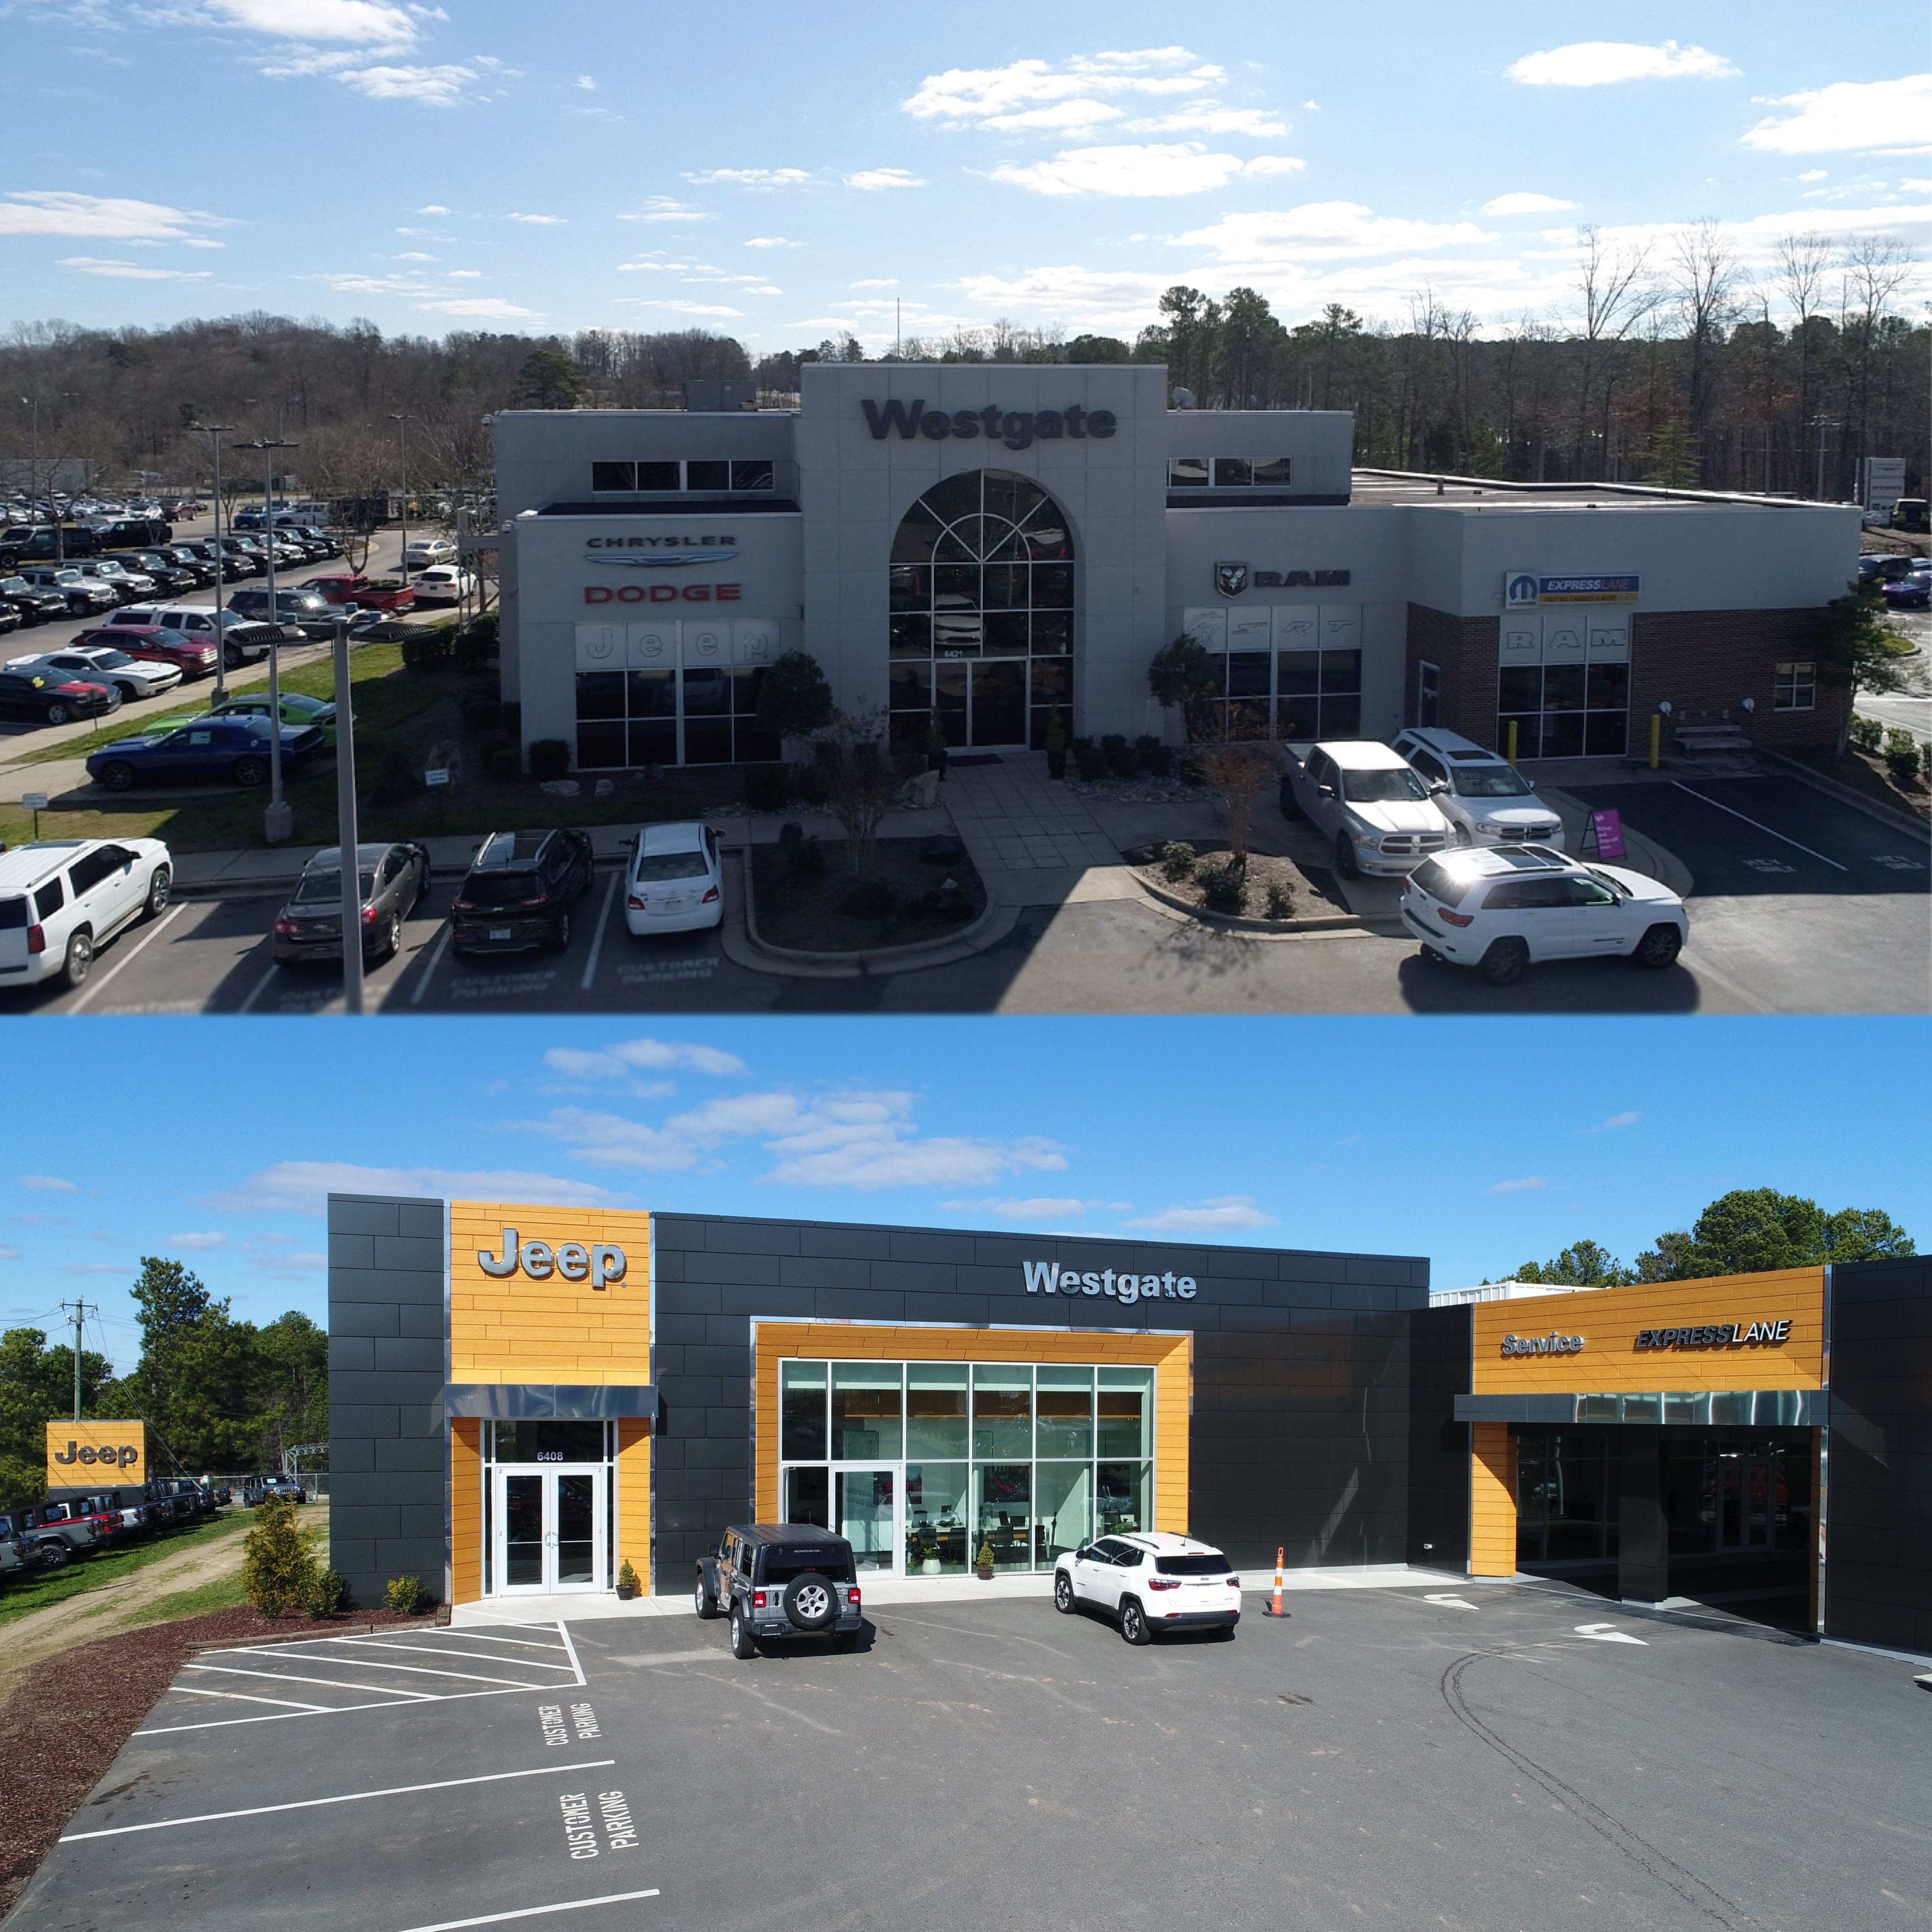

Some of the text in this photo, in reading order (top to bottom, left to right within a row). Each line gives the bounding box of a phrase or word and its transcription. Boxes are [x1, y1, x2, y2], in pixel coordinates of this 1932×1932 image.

[861, 399, 1117, 450] Westgate
[587, 536, 737, 548] CHRYSLER
[1254, 569, 1350, 588] RAM
[584, 583, 741, 605] DODGE
[1232, 619, 1355, 637] SRT
[1507, 628, 1626, 650] RAM
[587, 627, 769, 661] Jeep
[478, 1228, 627, 1289] Jeep
[1022, 1260, 1198, 1304] Westgate
[1502, 1331, 1585, 1355] Service
[1636, 1319, 1793, 1348] EXPRESSLANE
[55, 1441, 138, 1468] Jeep
[537, 1452, 564, 1462] 6408
[538, 1704, 569, 1746] CUSTOMER
[570, 1703, 602, 1739] PARKING
[559, 1792, 600, 1860] CUSTOMER
[598, 1790, 640, 1849] PARKING
